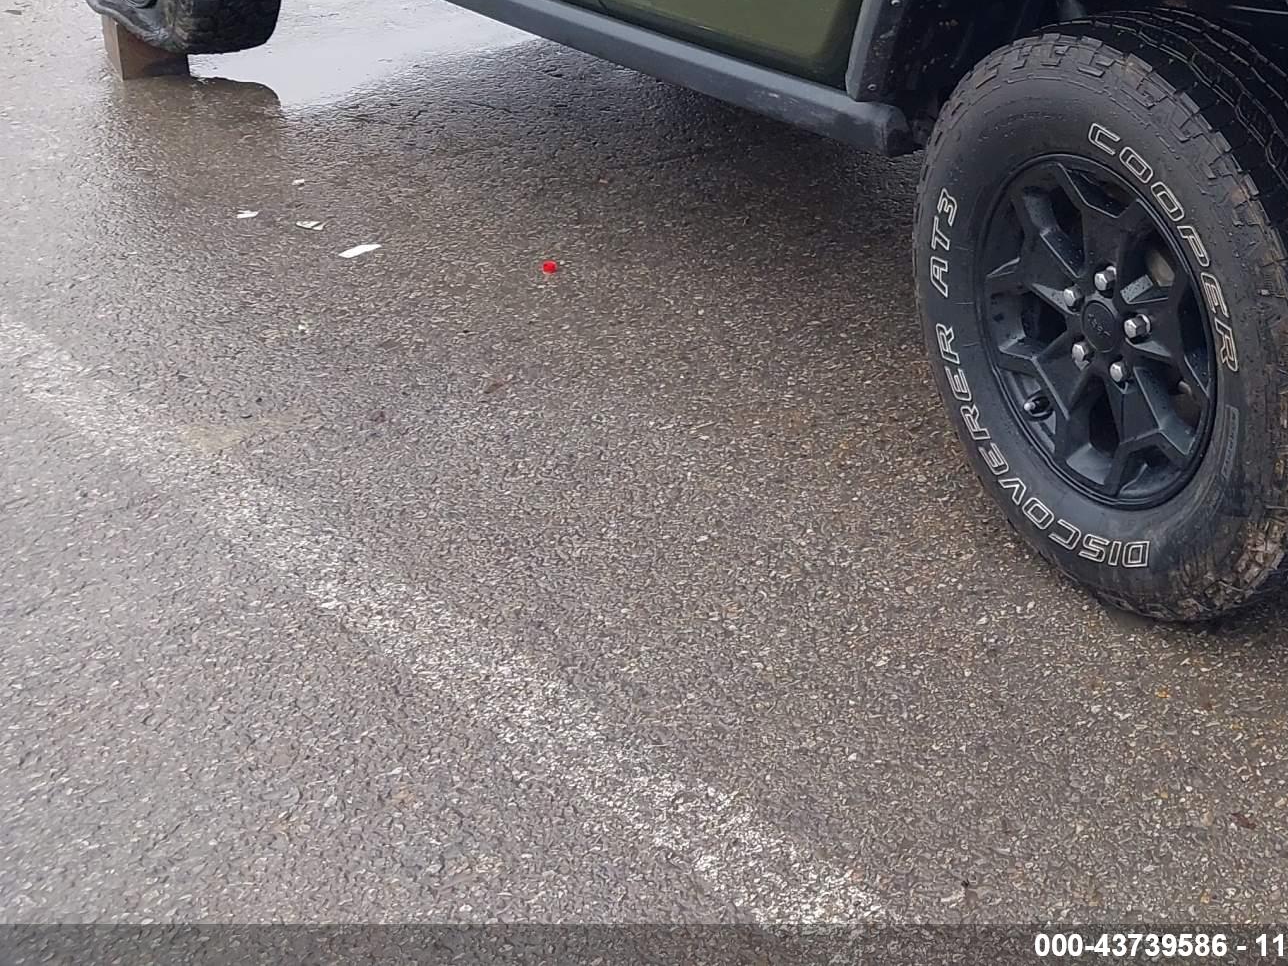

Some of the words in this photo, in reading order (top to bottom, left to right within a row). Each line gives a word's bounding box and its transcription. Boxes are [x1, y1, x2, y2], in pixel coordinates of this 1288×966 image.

[928, 186, 959, 298] AT3
[1087, 121, 1240, 374] COOPER
[933, 322, 1151, 569] DISCOVERER
